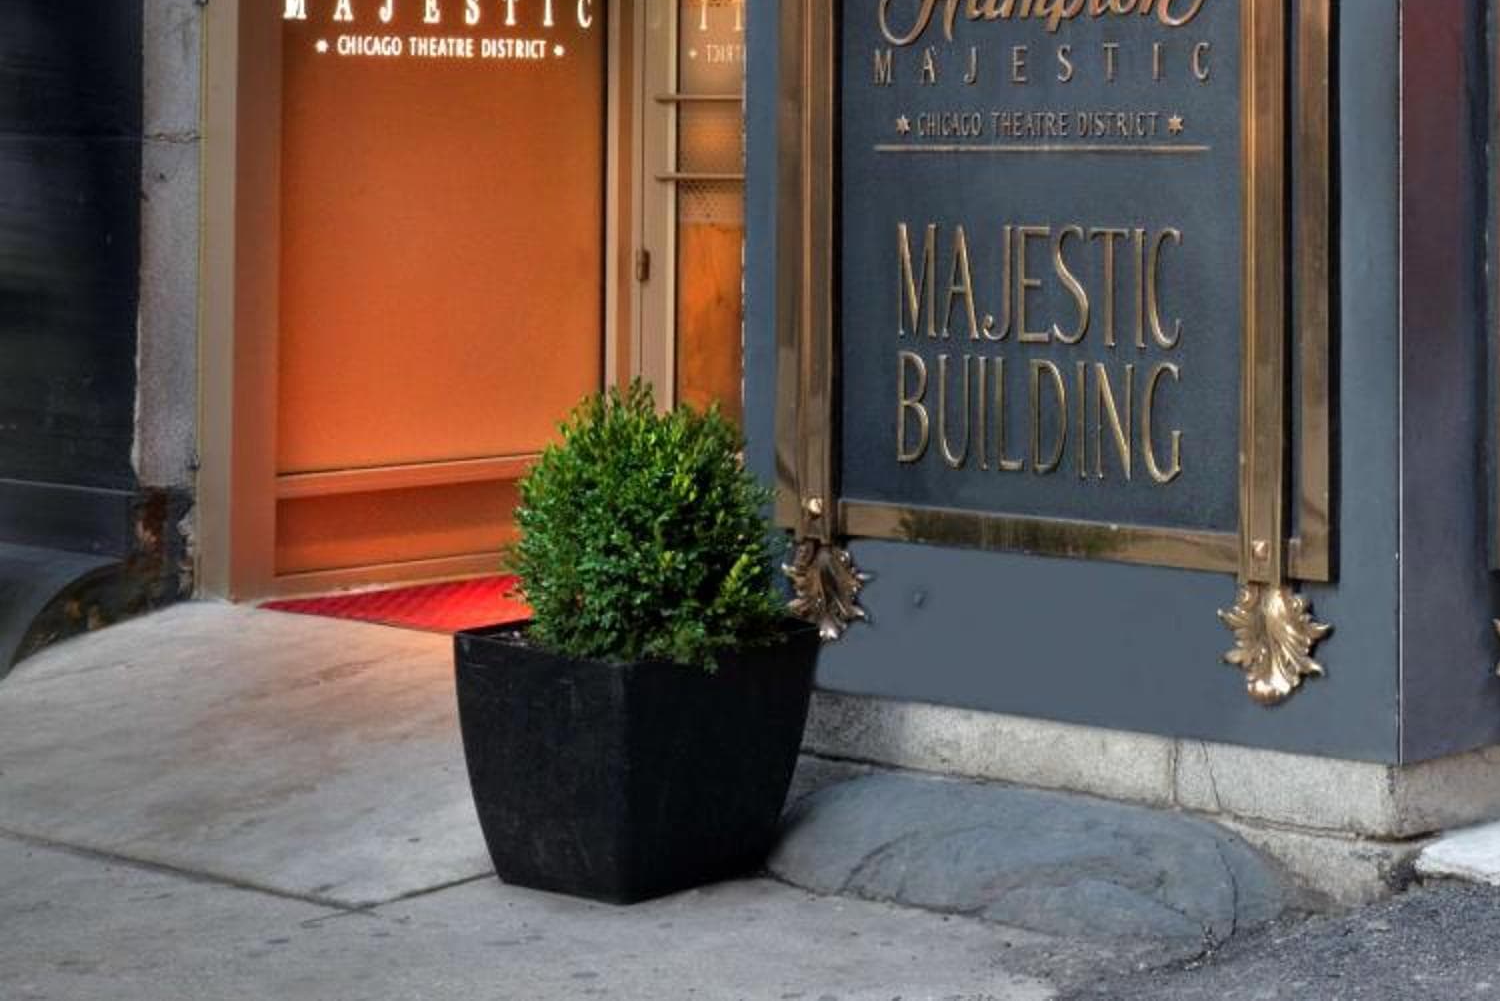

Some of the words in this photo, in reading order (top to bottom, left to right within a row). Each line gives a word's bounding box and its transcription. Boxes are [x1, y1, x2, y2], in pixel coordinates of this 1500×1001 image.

[337, 35, 403, 56] CHICAGO
[409, 36, 474, 58] THEATRE
[481, 38, 547, 59] DISTRICT
[873, 42, 1212, 86] MAJESTIC
[917, 112, 983, 137] CHICAGO
[991, 111, 1069, 137] THEATRE
[1077, 111, 1160, 137] DISTRICT
[896, 221, 1184, 350] MAJESTIC
[896, 350, 1184, 484] BUILDING
